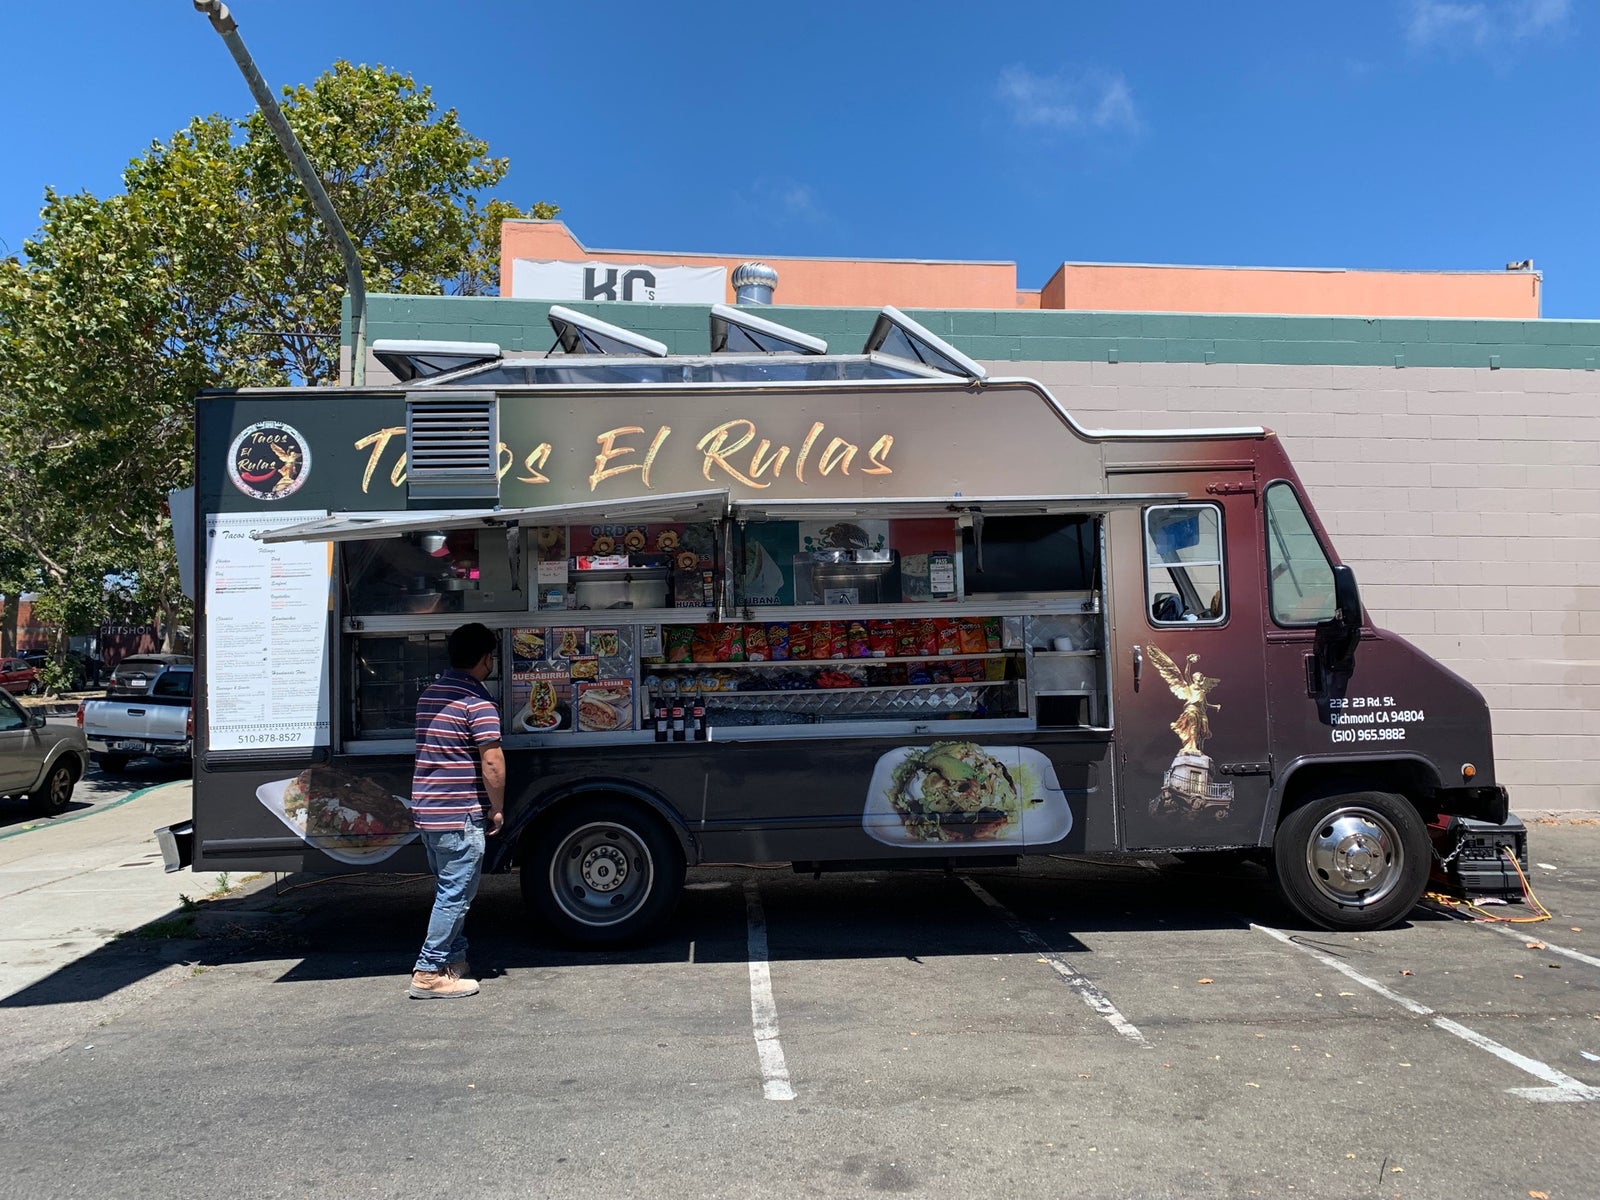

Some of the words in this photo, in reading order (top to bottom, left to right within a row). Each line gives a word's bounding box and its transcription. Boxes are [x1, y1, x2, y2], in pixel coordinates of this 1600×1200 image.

[251, 431, 288, 444] Tacos
[240, 447, 253, 457] El
[589, 424, 672, 492] El
[696, 417, 894, 489] Rulas
[237, 458, 276, 472] Rulas
[222, 530, 245, 540] Tacos
[512, 671, 570, 681] QUESABIRRIA
[1330, 698, 1349, 708] 232
[1352, 697, 1366, 708] 23
[1367, 697, 1382, 707] Rd.
[1383, 696, 1397, 707] St.
[1330, 712, 1375, 725] Richmond
[1376, 711, 1390, 723] CA
[1391, 710, 1425, 722] 94804
[238, 732, 302, 744] 510-878-8527
[1331, 729, 1356, 743] (510)
[1357, 728, 1406, 741] 965.9882
